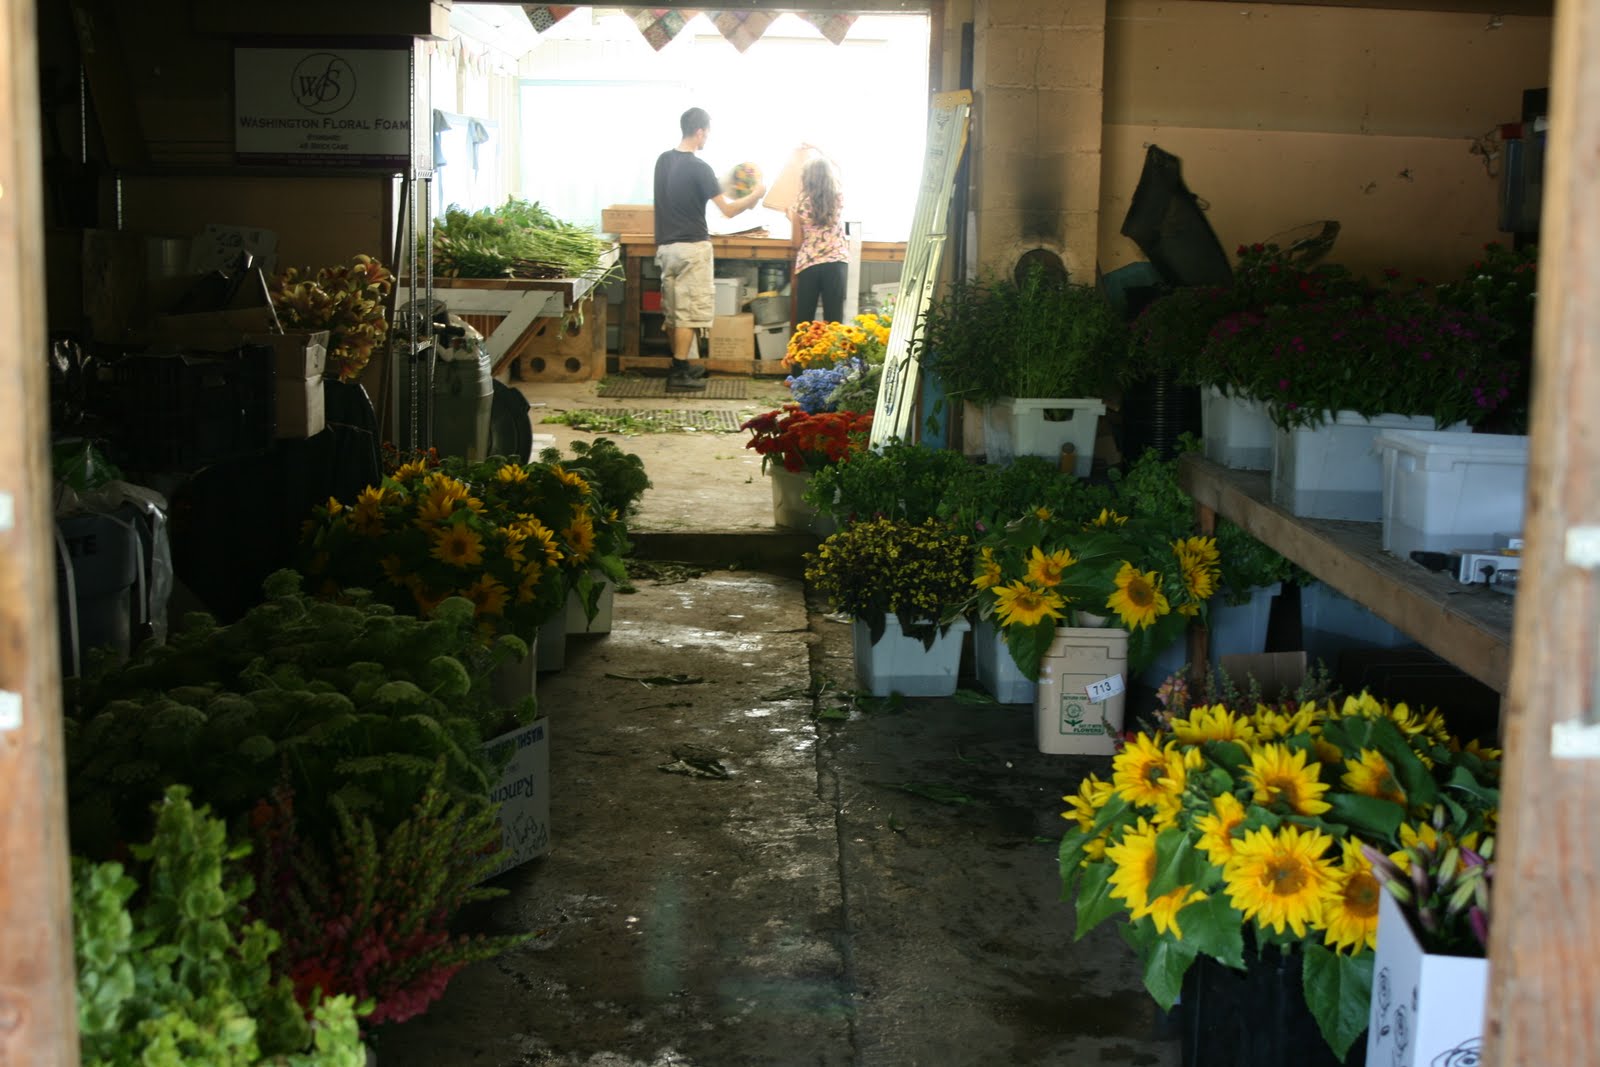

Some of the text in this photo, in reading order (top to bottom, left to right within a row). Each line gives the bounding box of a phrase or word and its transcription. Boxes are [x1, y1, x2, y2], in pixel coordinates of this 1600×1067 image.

[239, 116, 409, 131] WASHINGTON FLORAL FOAM
[1093, 681, 1112, 695] 713
